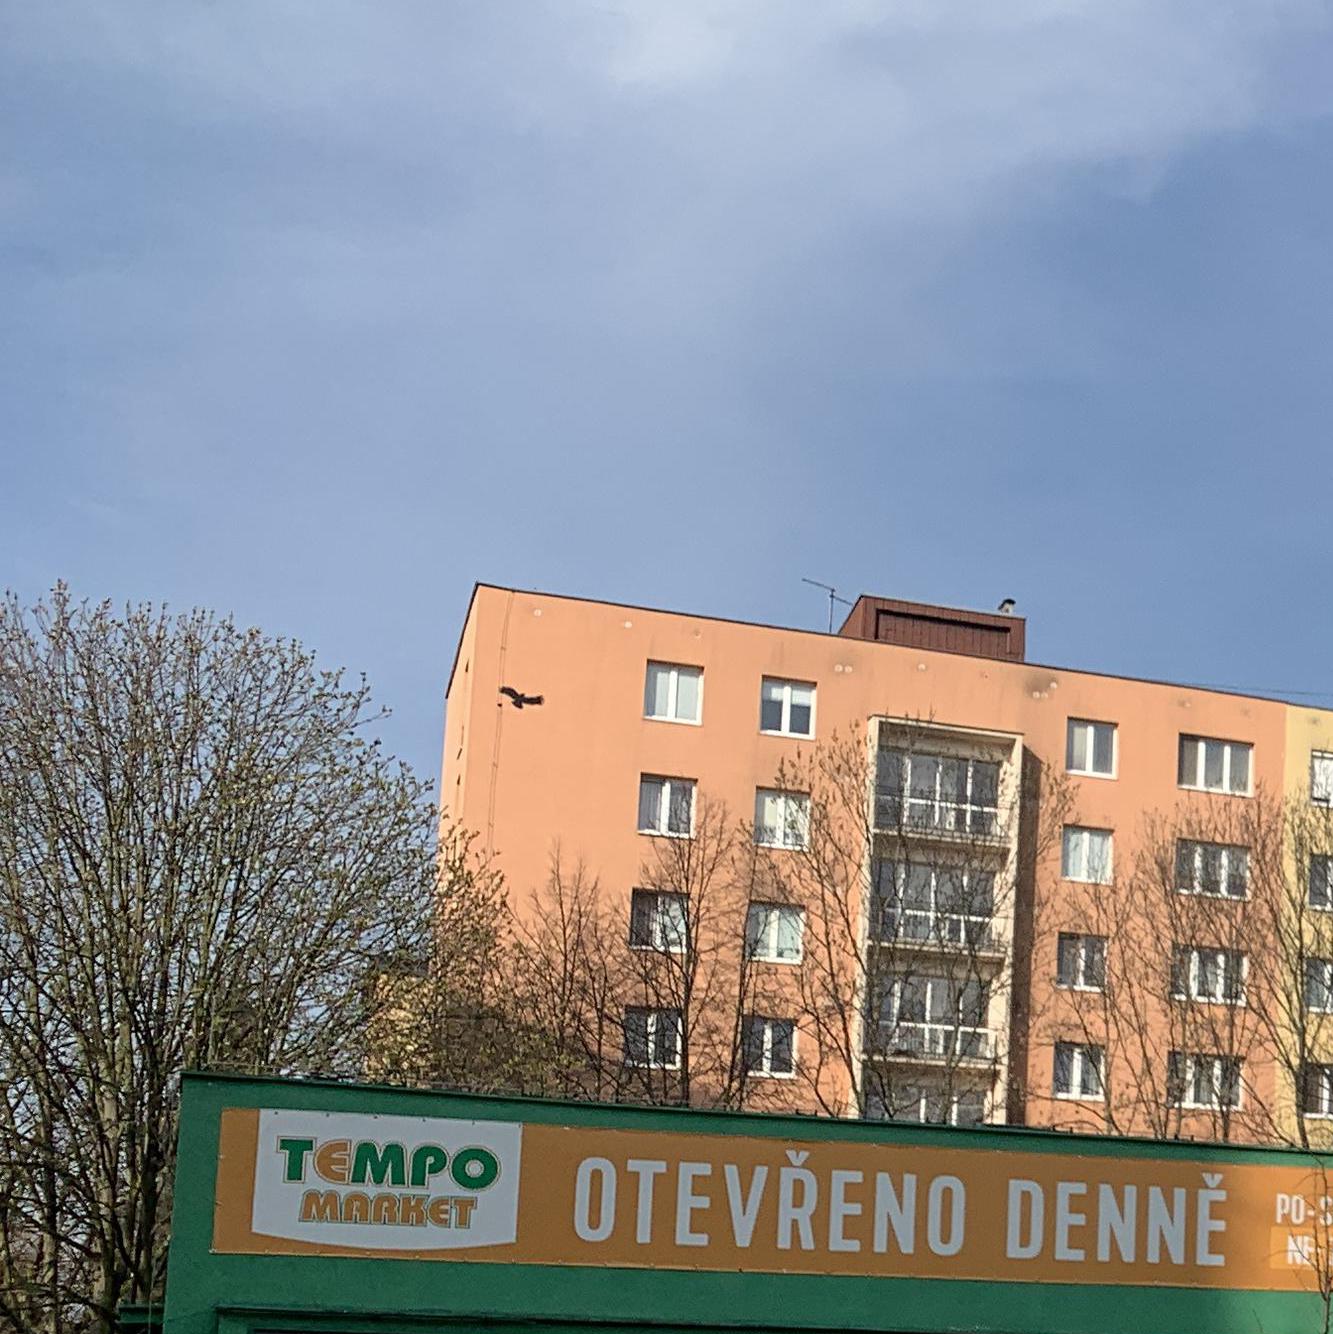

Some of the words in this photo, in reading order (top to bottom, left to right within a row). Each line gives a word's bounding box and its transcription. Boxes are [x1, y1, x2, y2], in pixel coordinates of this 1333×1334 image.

[276, 1136, 501, 1190] TEMPO
[299, 1189, 478, 1228] MARKET
[574, 1150, 966, 1257] OTEVŘENO
[1006, 1173, 1227, 1267] DENNĚ
